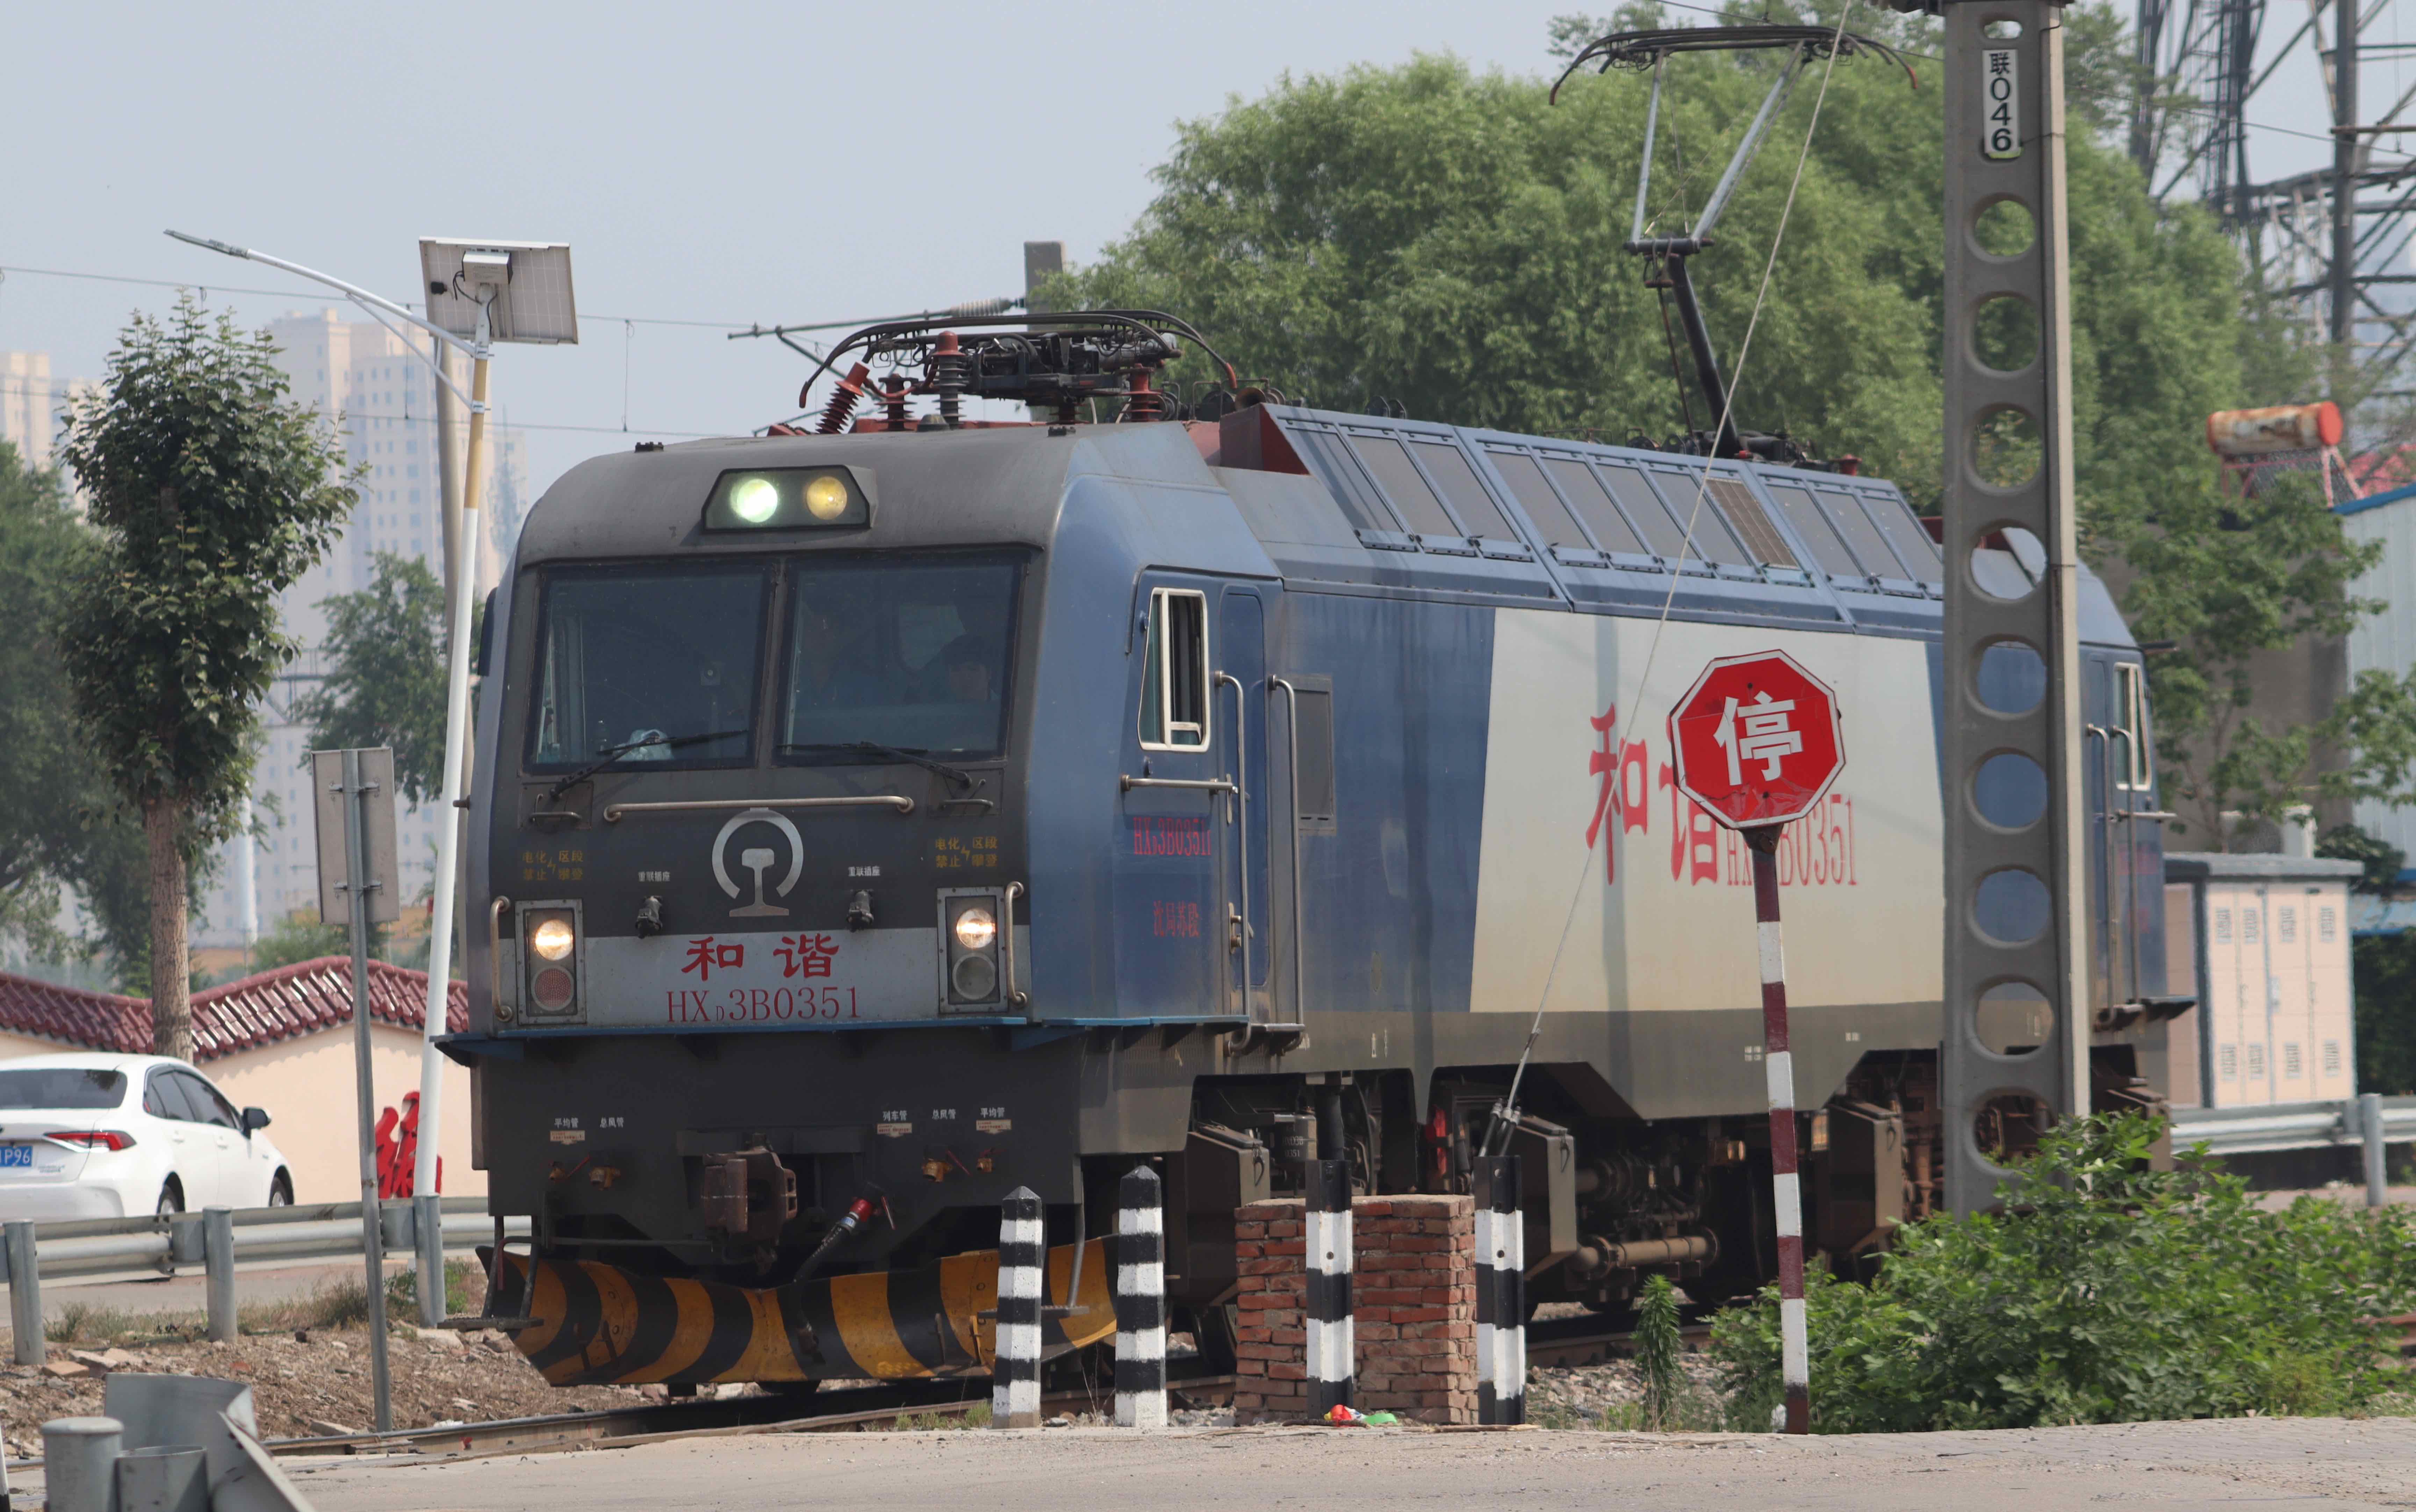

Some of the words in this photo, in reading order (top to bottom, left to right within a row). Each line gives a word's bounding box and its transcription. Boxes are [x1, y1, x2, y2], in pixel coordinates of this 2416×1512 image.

[1989, 52, 2012, 152] 联046
[1713, 690, 1805, 786] 停
[681, 933, 840, 982] 和谐
[666, 986, 861, 1022] HXD3B0351
[554, 1117, 579, 1129] 平均管
[883, 1110, 907, 1122] 列车管
[980, 1107, 1005, 1118] 平均管
[0, 1148, 30, 1165] P96
